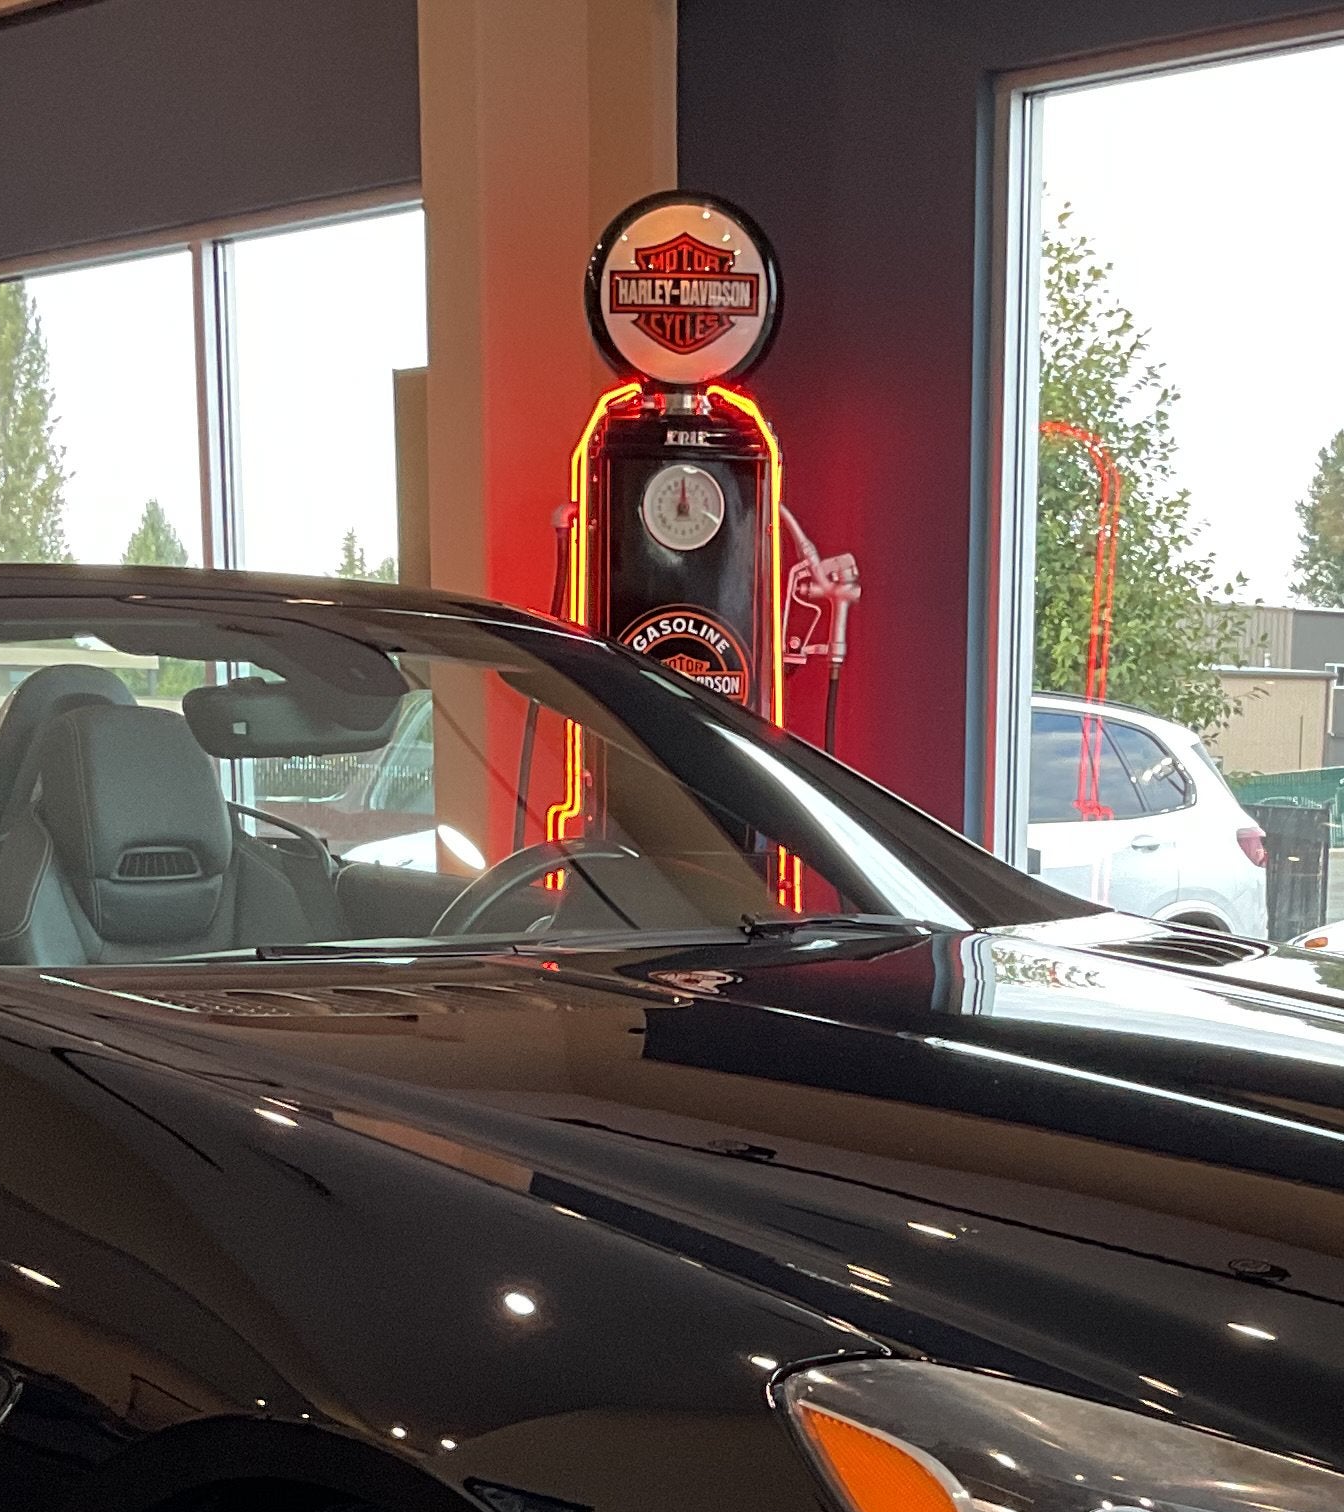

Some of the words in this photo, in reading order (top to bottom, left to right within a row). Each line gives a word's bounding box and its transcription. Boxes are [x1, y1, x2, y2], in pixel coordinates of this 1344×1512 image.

[650, 244, 719, 272] MOTOR
[618, 278, 751, 307] HARLEY-DAVIDSON
[650, 313, 719, 346] CYCLES
[632, 618, 730, 655] GASOLINE
